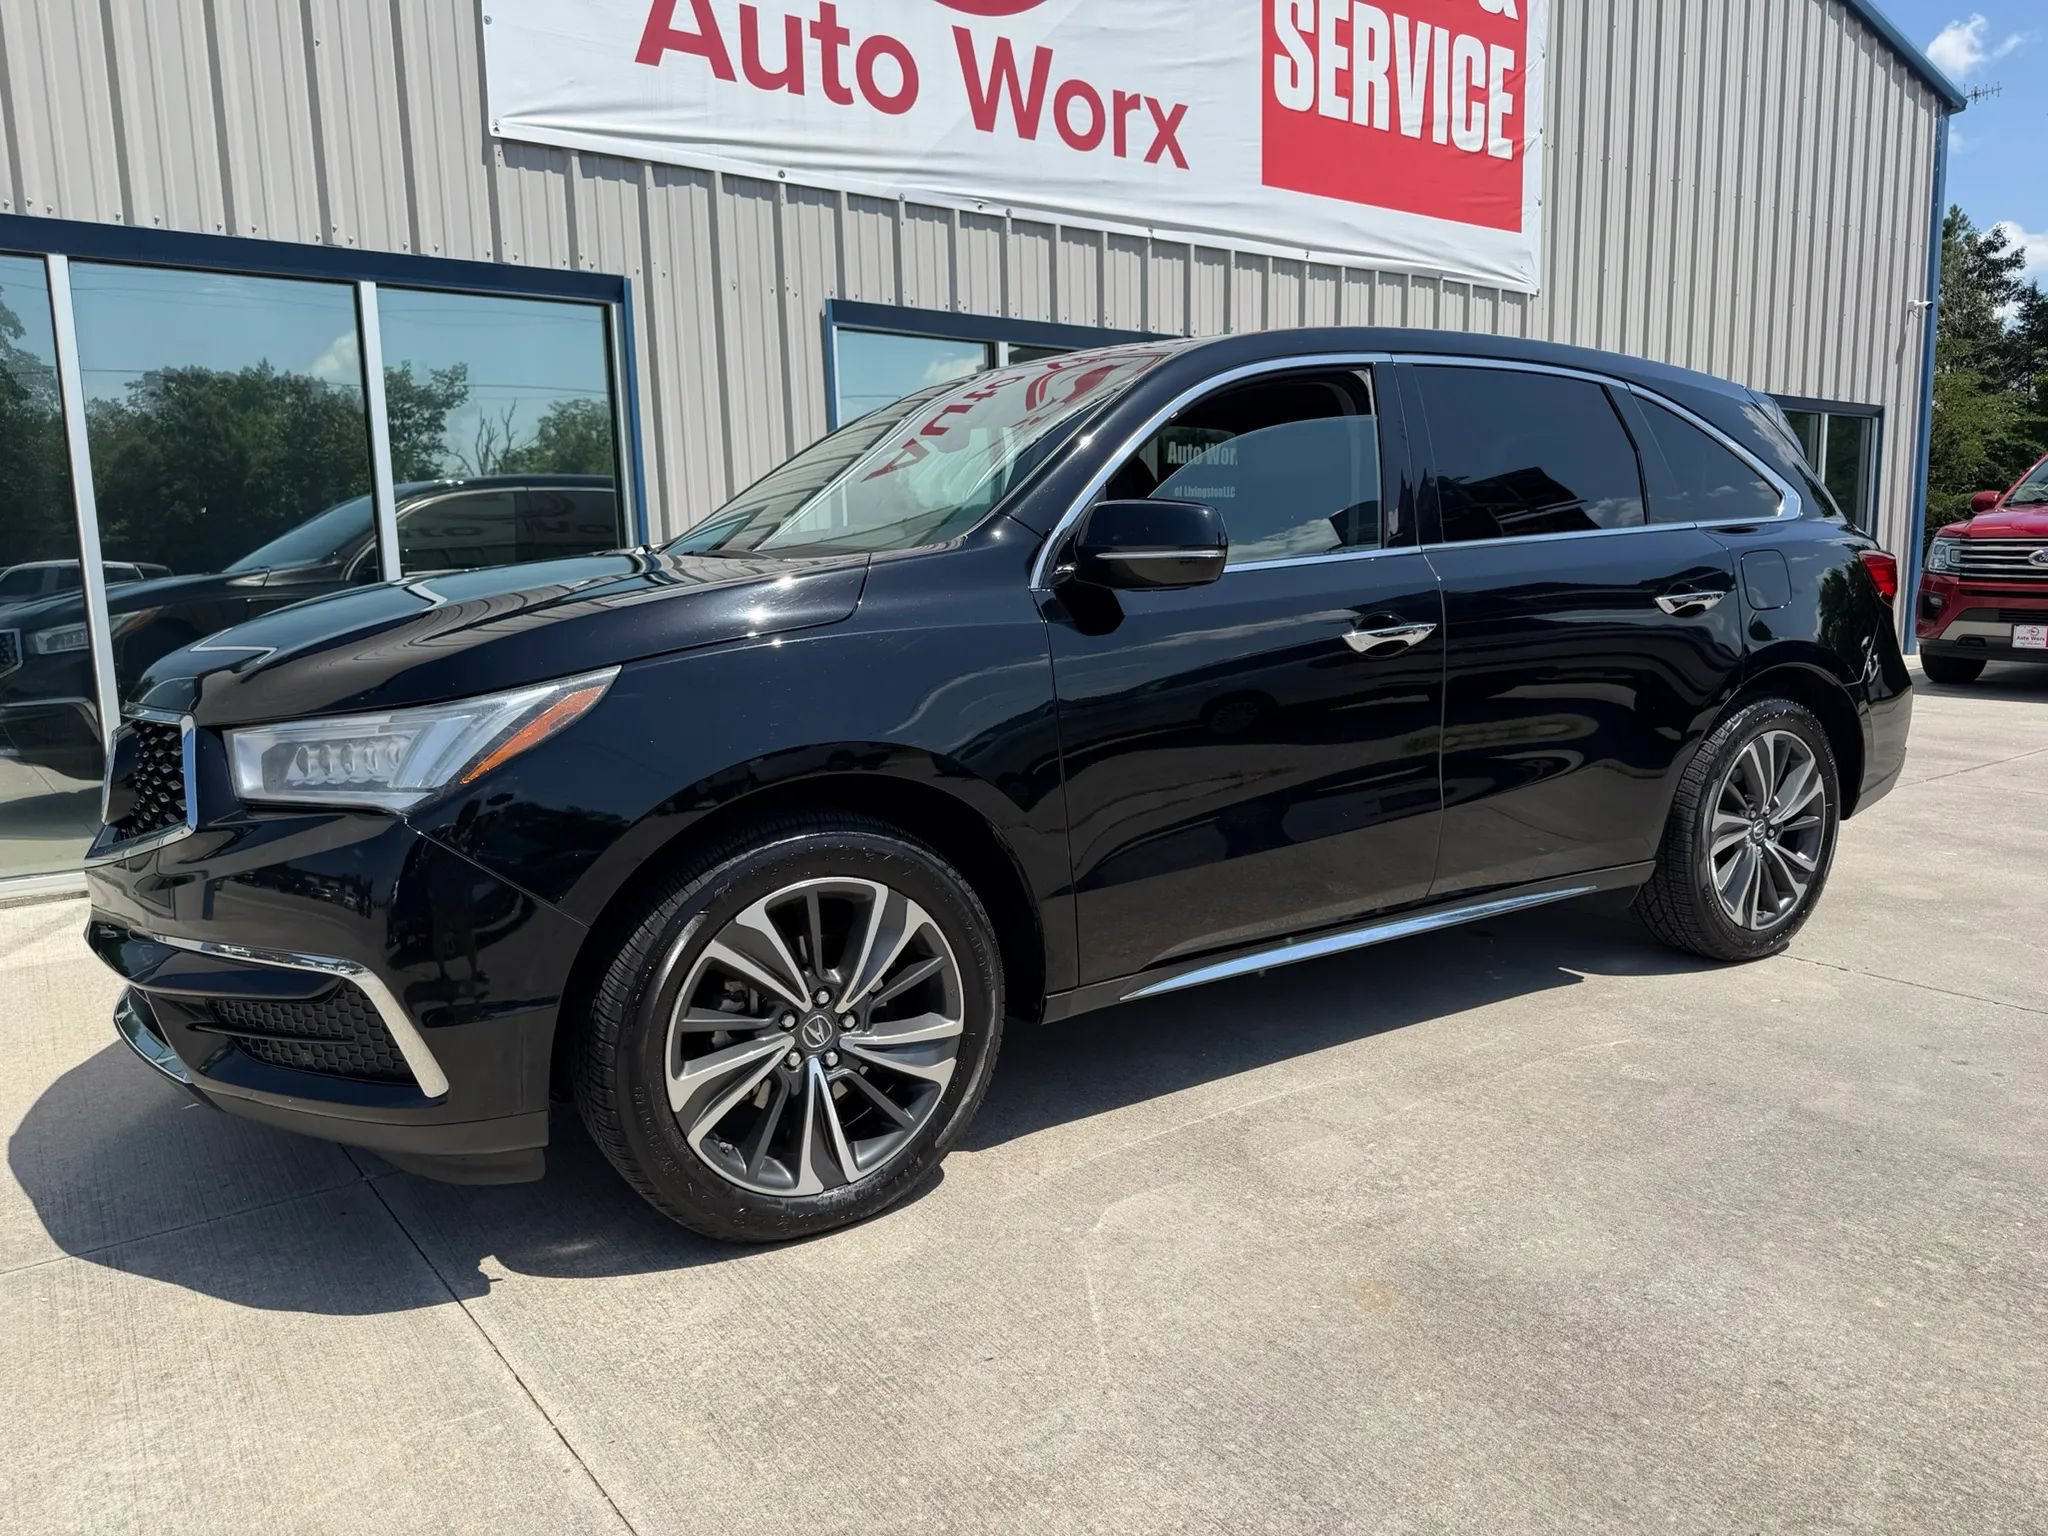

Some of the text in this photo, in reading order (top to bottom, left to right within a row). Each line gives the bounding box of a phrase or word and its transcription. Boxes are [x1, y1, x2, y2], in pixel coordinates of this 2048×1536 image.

[635, 0, 1190, 170] Auto Worx
[1274, 0, 1515, 160] SERVICE
[1167, 441, 1202, 464] Auto
